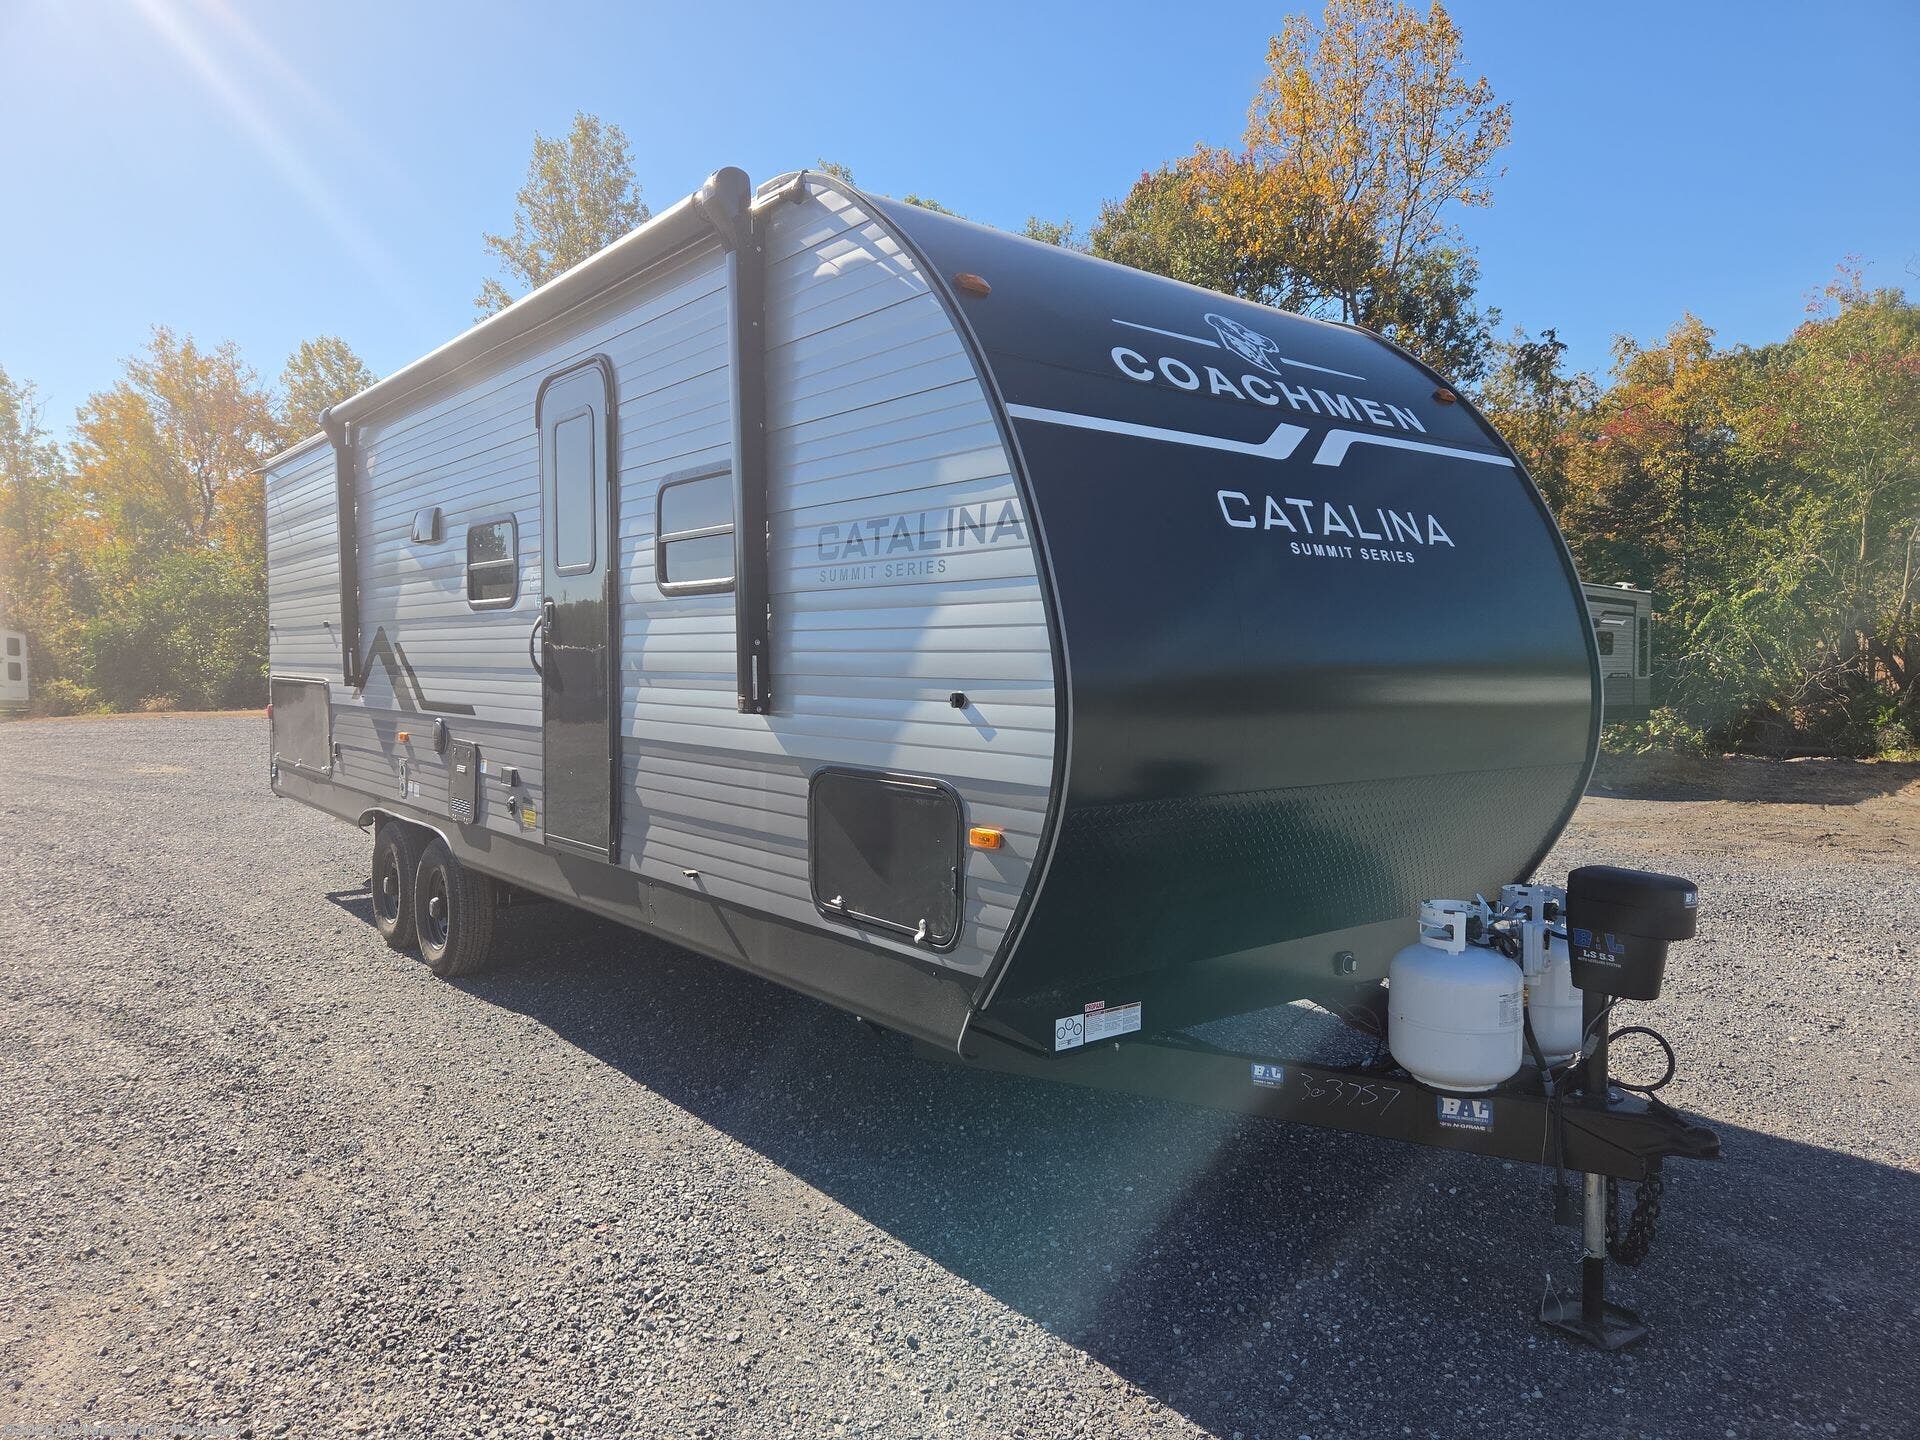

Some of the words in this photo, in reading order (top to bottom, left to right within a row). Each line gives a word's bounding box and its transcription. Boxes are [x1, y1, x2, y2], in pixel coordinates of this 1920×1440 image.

[1111, 346, 1427, 433] COACHMEN
[817, 500, 1024, 561] CATALINA
[1217, 490, 1455, 547] CATALINA
[819, 566, 876, 583] SUMMIT
[885, 559, 946, 578] SERIES
[1291, 542, 1352, 559] SUMMIT
[1360, 548, 1415, 564] SERIES
[1442, 1098, 1489, 1118] BAL
